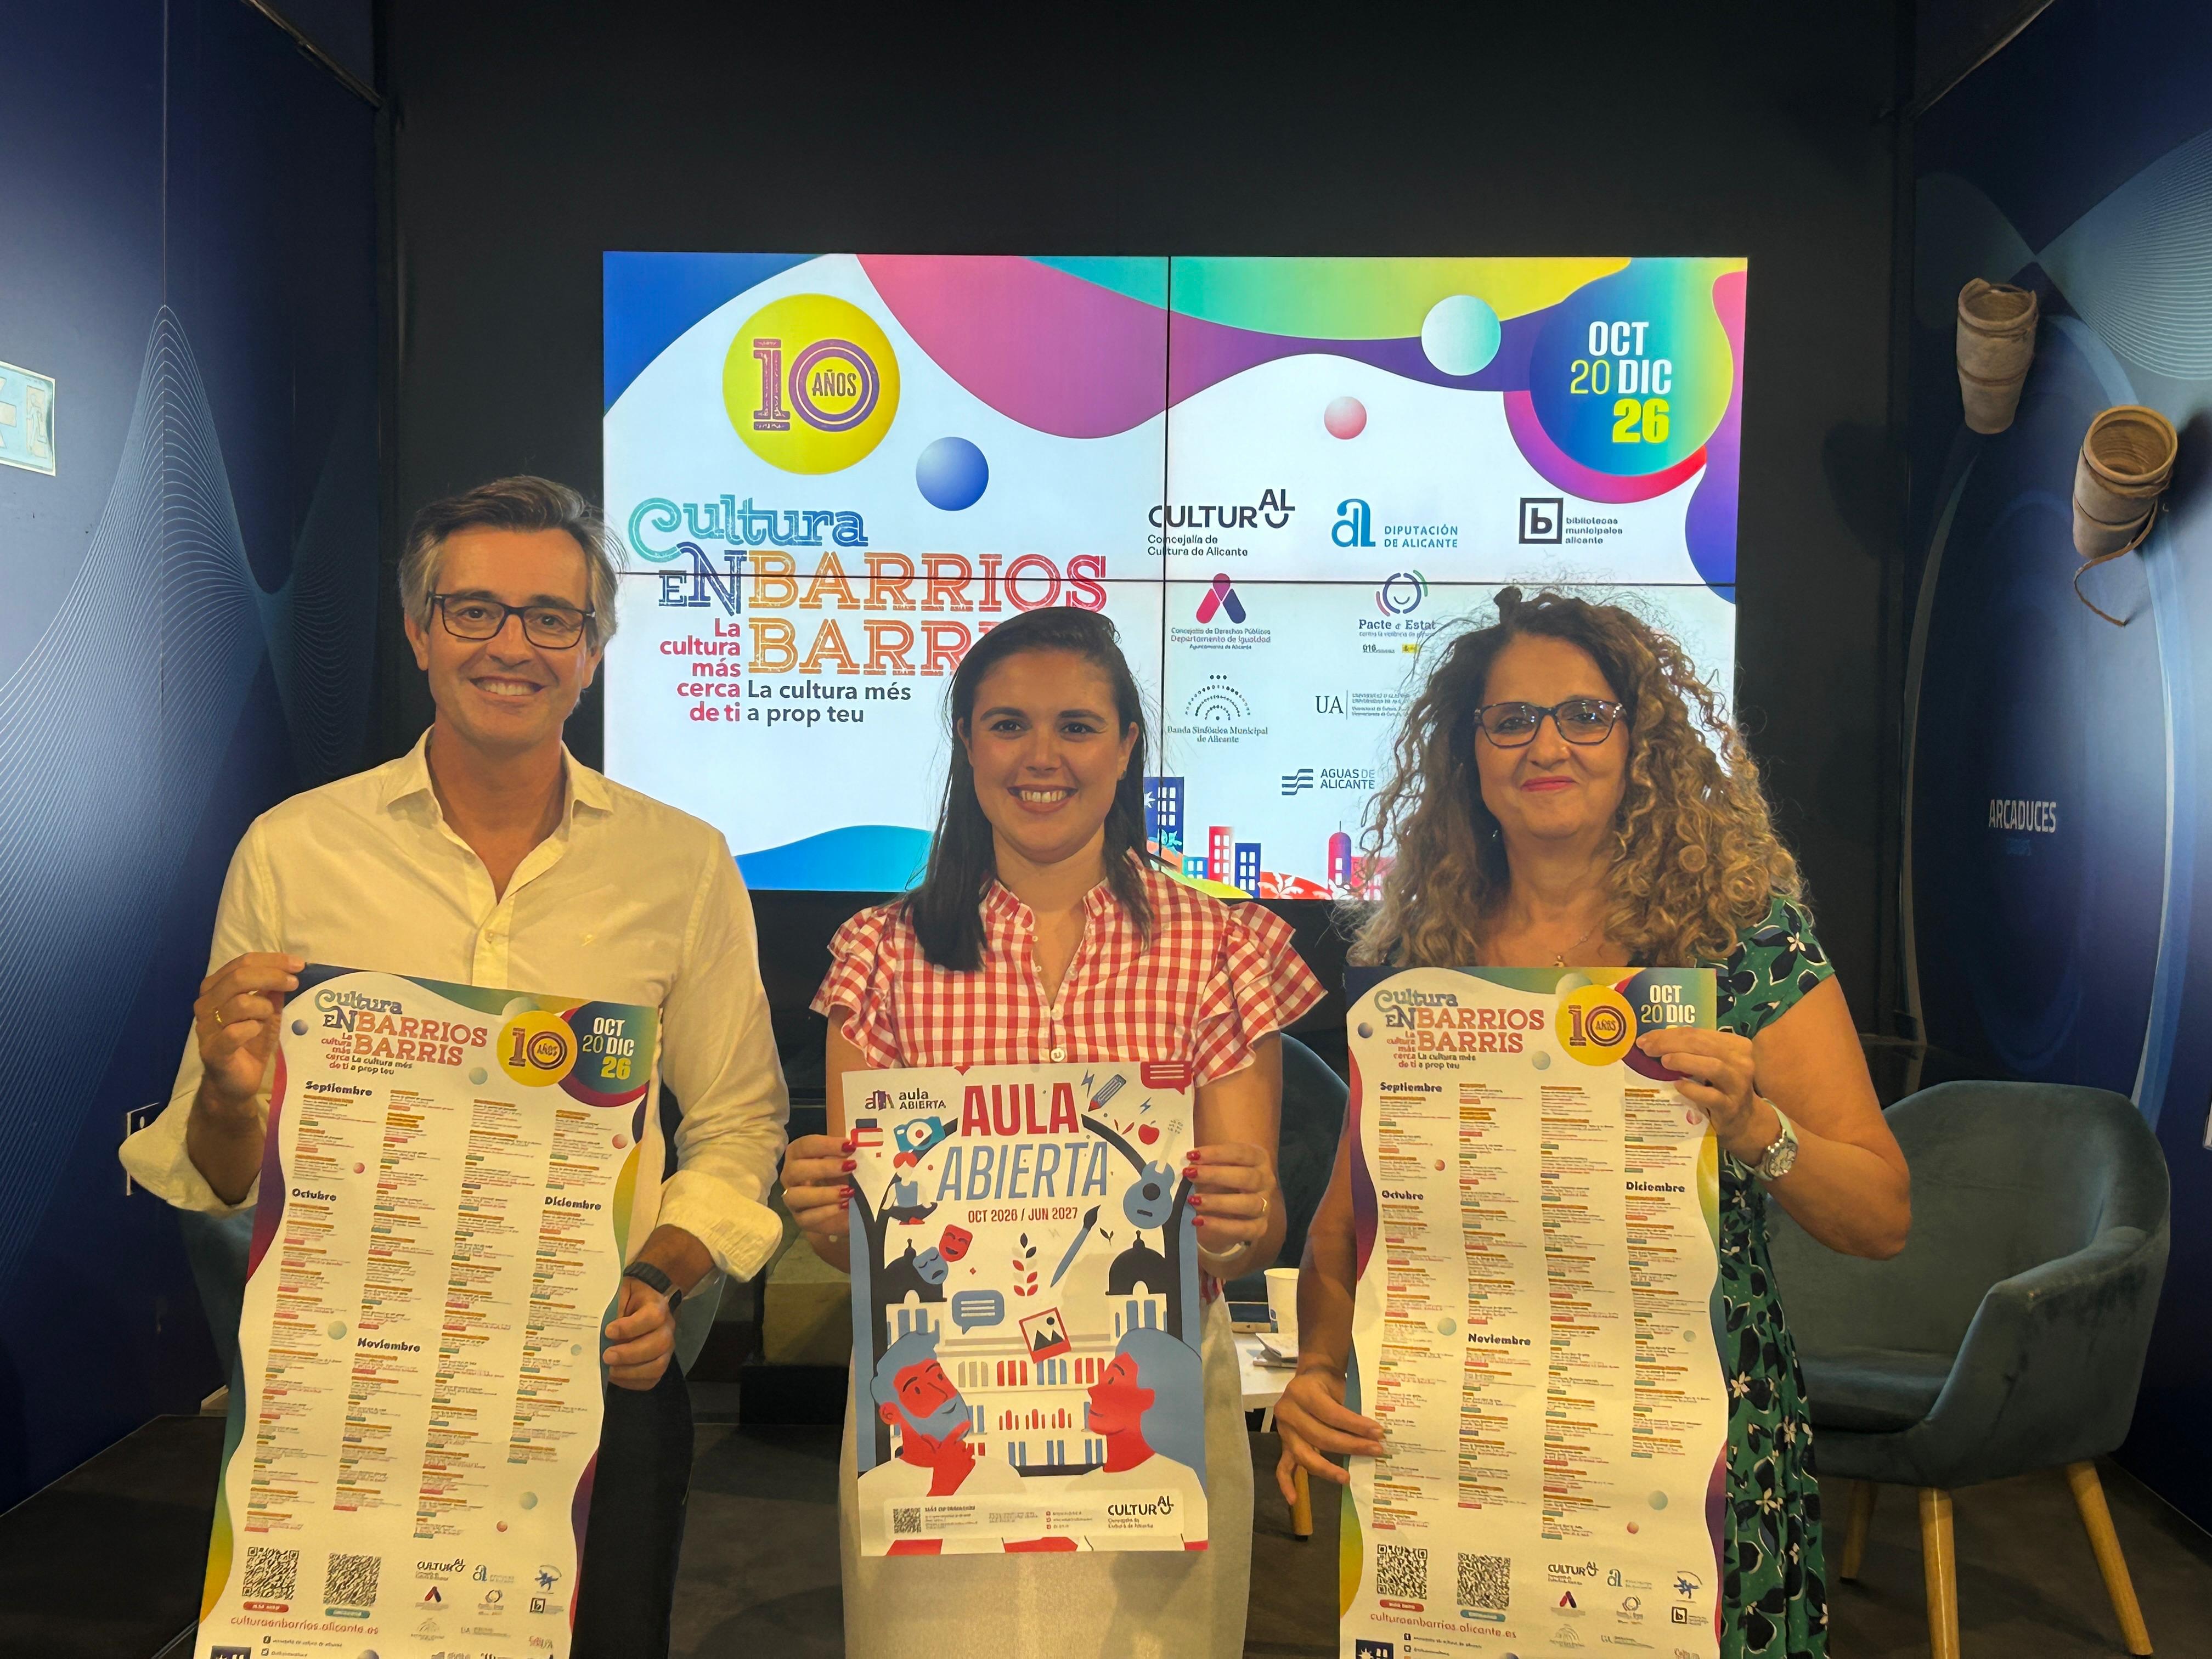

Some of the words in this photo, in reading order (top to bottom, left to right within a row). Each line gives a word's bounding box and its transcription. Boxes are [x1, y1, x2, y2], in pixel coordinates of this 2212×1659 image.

[1589, 321, 1649, 356] OCT
[753, 338, 879, 432] 10
[812, 369, 856, 397] AÑOS
[1570, 359, 1610, 394] 20
[1618, 359, 1672, 394] DIC
[1612, 398, 1669, 443] 26
[628, 494, 868, 562] Cultura
[1384, 523, 1458, 536] DIPUTACIÓN
[1148, 535, 1203, 546] Concejalía
[1205, 535, 1218, 544] de
[1384, 539, 1398, 548] DE
[1402, 538, 1458, 548] ALICANTE
[1565, 536, 1603, 544] alicante
[1148, 547, 1189, 556] Cultura
[1192, 547, 1204, 556] de
[1206, 547, 1248, 556] Alicante
[748, 551, 1108, 611] BARRIOS
[715, 618, 741, 637] La
[1359, 619, 1392, 629] Pacte
[659, 637, 741, 656] cultura
[748, 618, 1001, 675] BARR
[692, 658, 741, 678] más
[676, 681, 741, 698] cerca
[748, 680, 772, 698] La
[779, 681, 857, 700] cultura
[865, 681, 911, 701] més
[690, 702, 720, 723] de
[723, 702, 740, 723] ti
[1316, 696, 1344, 714] UA
[747, 707, 759, 723] a
[766, 707, 821, 727] prop
[827, 704, 864, 723] teu
[1230, 726, 1268, 736] Municipal
[1321, 769, 1359, 778] AGUAS
[1361, 769, 1375, 778] DE
[1321, 780, 1375, 789] ALICANTE
[1989, 799, 2057, 833] ARCADUCES
[315, 989, 403, 1014] Cultura
[1374, 988, 1458, 1012] Cultura
[1650, 985, 1683, 1003] OCT
[1416, 1007, 1545, 1031] BARRIOS
[1641, 1005, 1662, 1023] 20
[1666, 1005, 1695, 1024] DIC
[356, 1011, 488, 1047] BARRIOS
[593, 1017, 625, 1036] OCT
[1568, 1005, 1627, 1046] 10
[321, 1038, 352, 1047] cultura
[353, 1034, 464, 1066] BARRIS
[509, 1027, 567, 1070] 10
[583, 1034, 604, 1053] 20
[606, 1037, 635, 1057] DIC
[1417, 1030, 1523, 1053] BARRIS
[326, 1053, 349, 1062] cerca
[357, 1064, 378, 1074] prop
[601, 1056, 631, 1080] 26
[304, 1080, 373, 1097] Septiembre
[899, 1088, 929, 1100] aula
[1380, 1082, 1443, 1093] Septiembre
[900, 1100, 946, 1109] ABIERTA
[961, 1082, 1079, 1137] AULA
[936, 1141, 1108, 1201] ABIERTA
[292, 1188, 337, 1201] Octubre
[1381, 1190, 1424, 1200] Octubre
[1626, 1181, 1685, 1193] Diciembre
[545, 1196, 601, 1211] Diciembre
[968, 1210, 987, 1223] OCT
[1028, 1208, 1048, 1221] JUN
[1052, 1207, 1078, 1220] 2027
[357, 1337, 421, 1352] Noviembre
[1468, 1333, 1531, 1346] Noviembre
